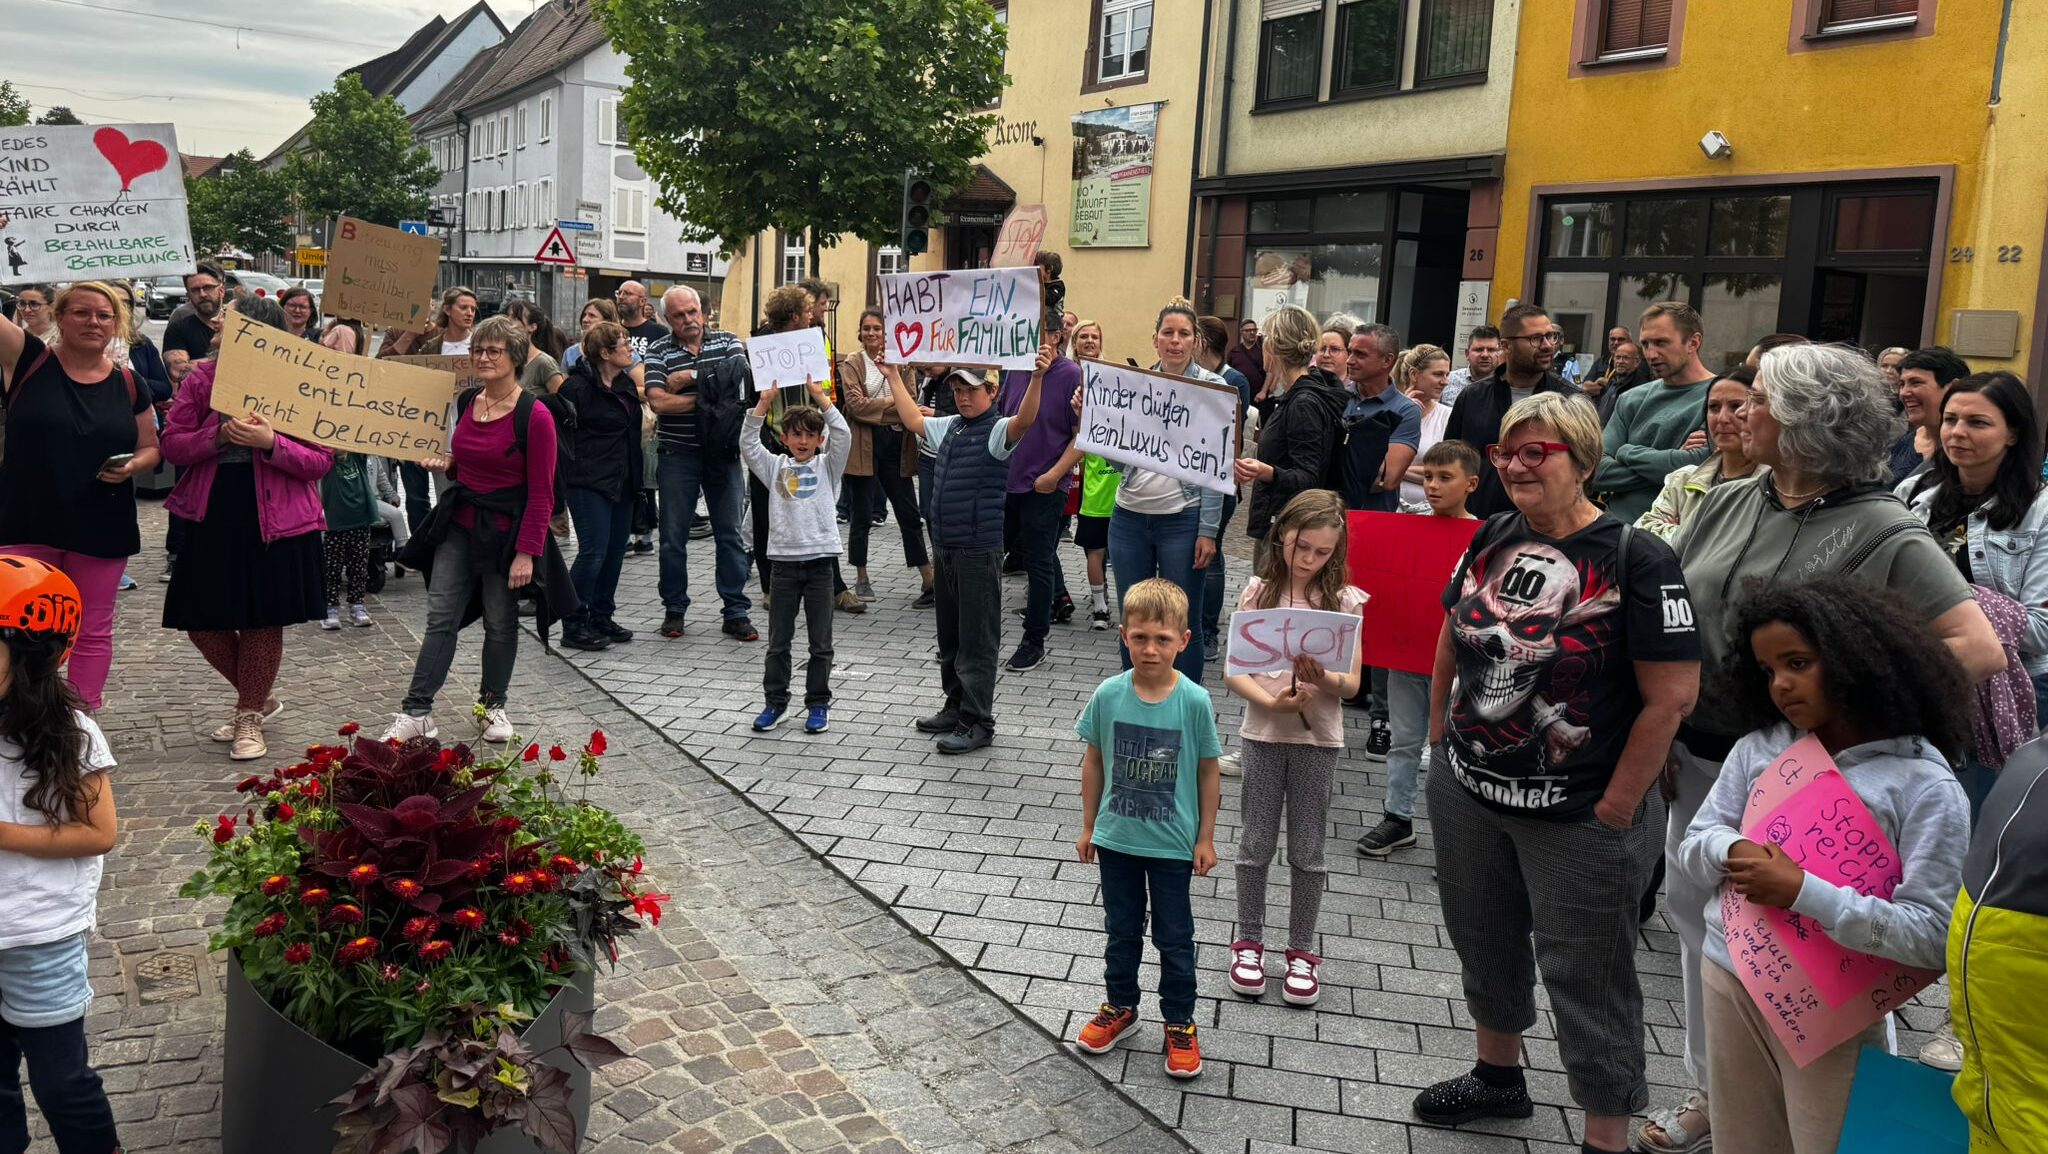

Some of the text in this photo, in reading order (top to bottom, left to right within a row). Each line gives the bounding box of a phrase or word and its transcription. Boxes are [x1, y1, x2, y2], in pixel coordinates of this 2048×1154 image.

[992, 115, 1038, 147] Krone
[0, 202, 149, 221] FAIRE CHANCEN
[55, 220, 120, 234] DURCH
[44, 235, 169, 252] BEZAHLBARE
[1470, 250, 1484, 261] 26
[1951, 248, 1974, 263] 24
[1997, 246, 2022, 263] 22
[886, 273, 951, 317] HABT
[755, 343, 816, 369] STOP
[242, 391, 301, 424] nicht
[1085, 364, 1191, 430] Kinder dürfen
[1177, 425, 1230, 480] sein!
[1126, 758, 1178, 784] OCEAN
[1821, 798, 1890, 869] Stopp
[1743, 928, 1765, 956] und
[1764, 961, 1782, 983] ich
[1783, 993, 1804, 1018] will
[1740, 949, 1762, 978] eine
[1764, 991, 1806, 1043] andere
